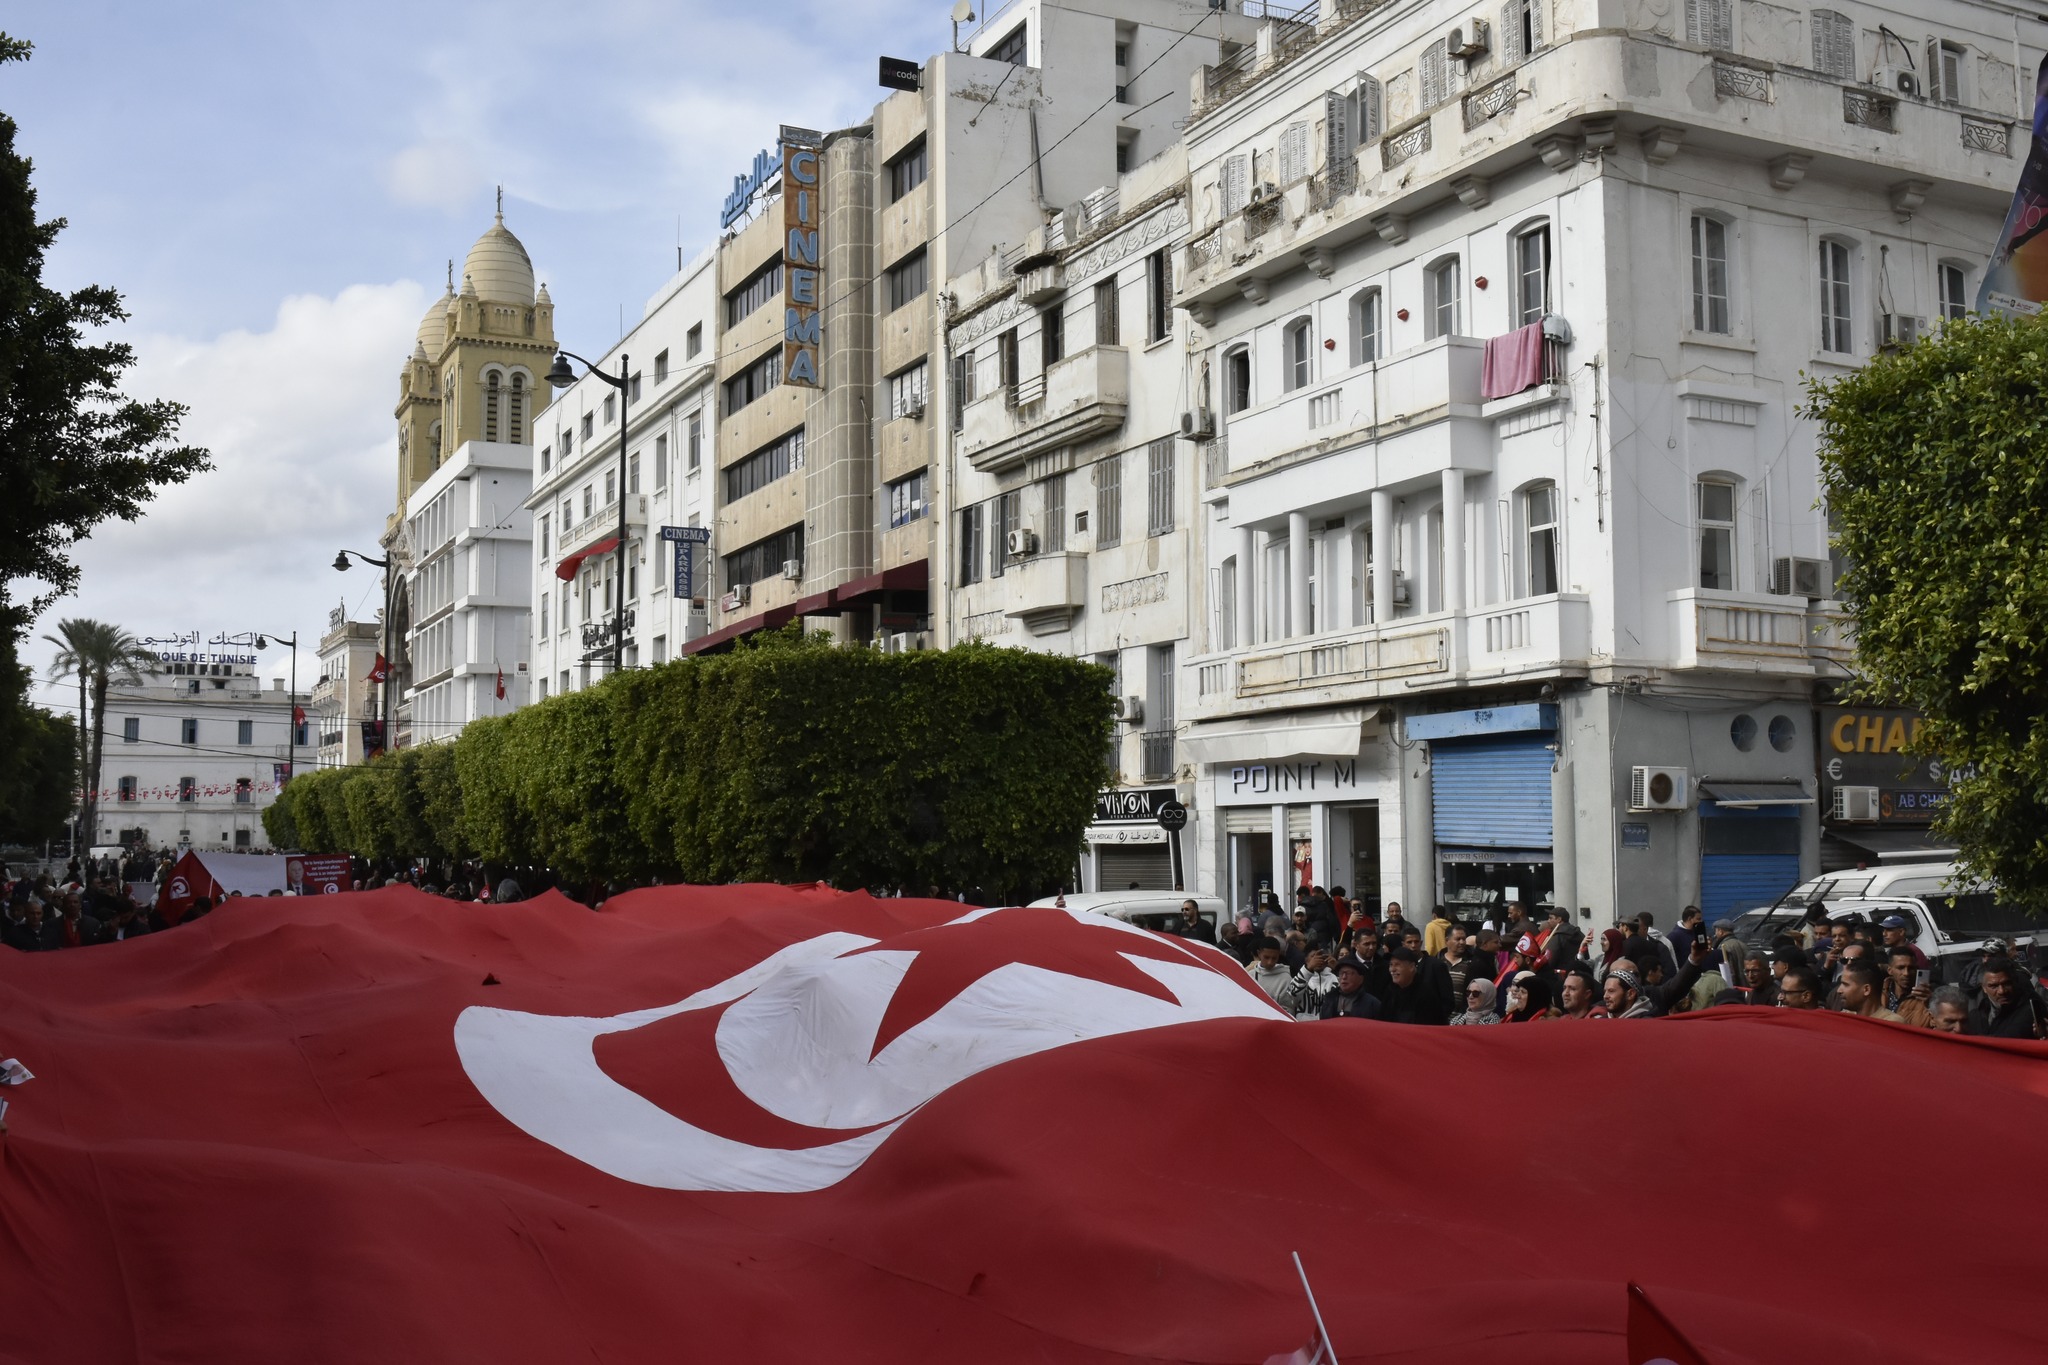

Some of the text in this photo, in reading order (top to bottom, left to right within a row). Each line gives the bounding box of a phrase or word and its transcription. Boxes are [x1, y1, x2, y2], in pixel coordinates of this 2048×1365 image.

[785, 151, 820, 384] CINEMA
[665, 528, 706, 540] CINEMA
[678, 549, 689, 597] PARNASSE
[136, 630, 258, 648] البنك التونسي
[190, 653, 206, 662] DE
[211, 654, 257, 665] TUNISIE
[1231, 759, 1356, 794] POINT M
[1104, 792, 1151, 815] VISION
[1898, 794, 1916, 808] AB
